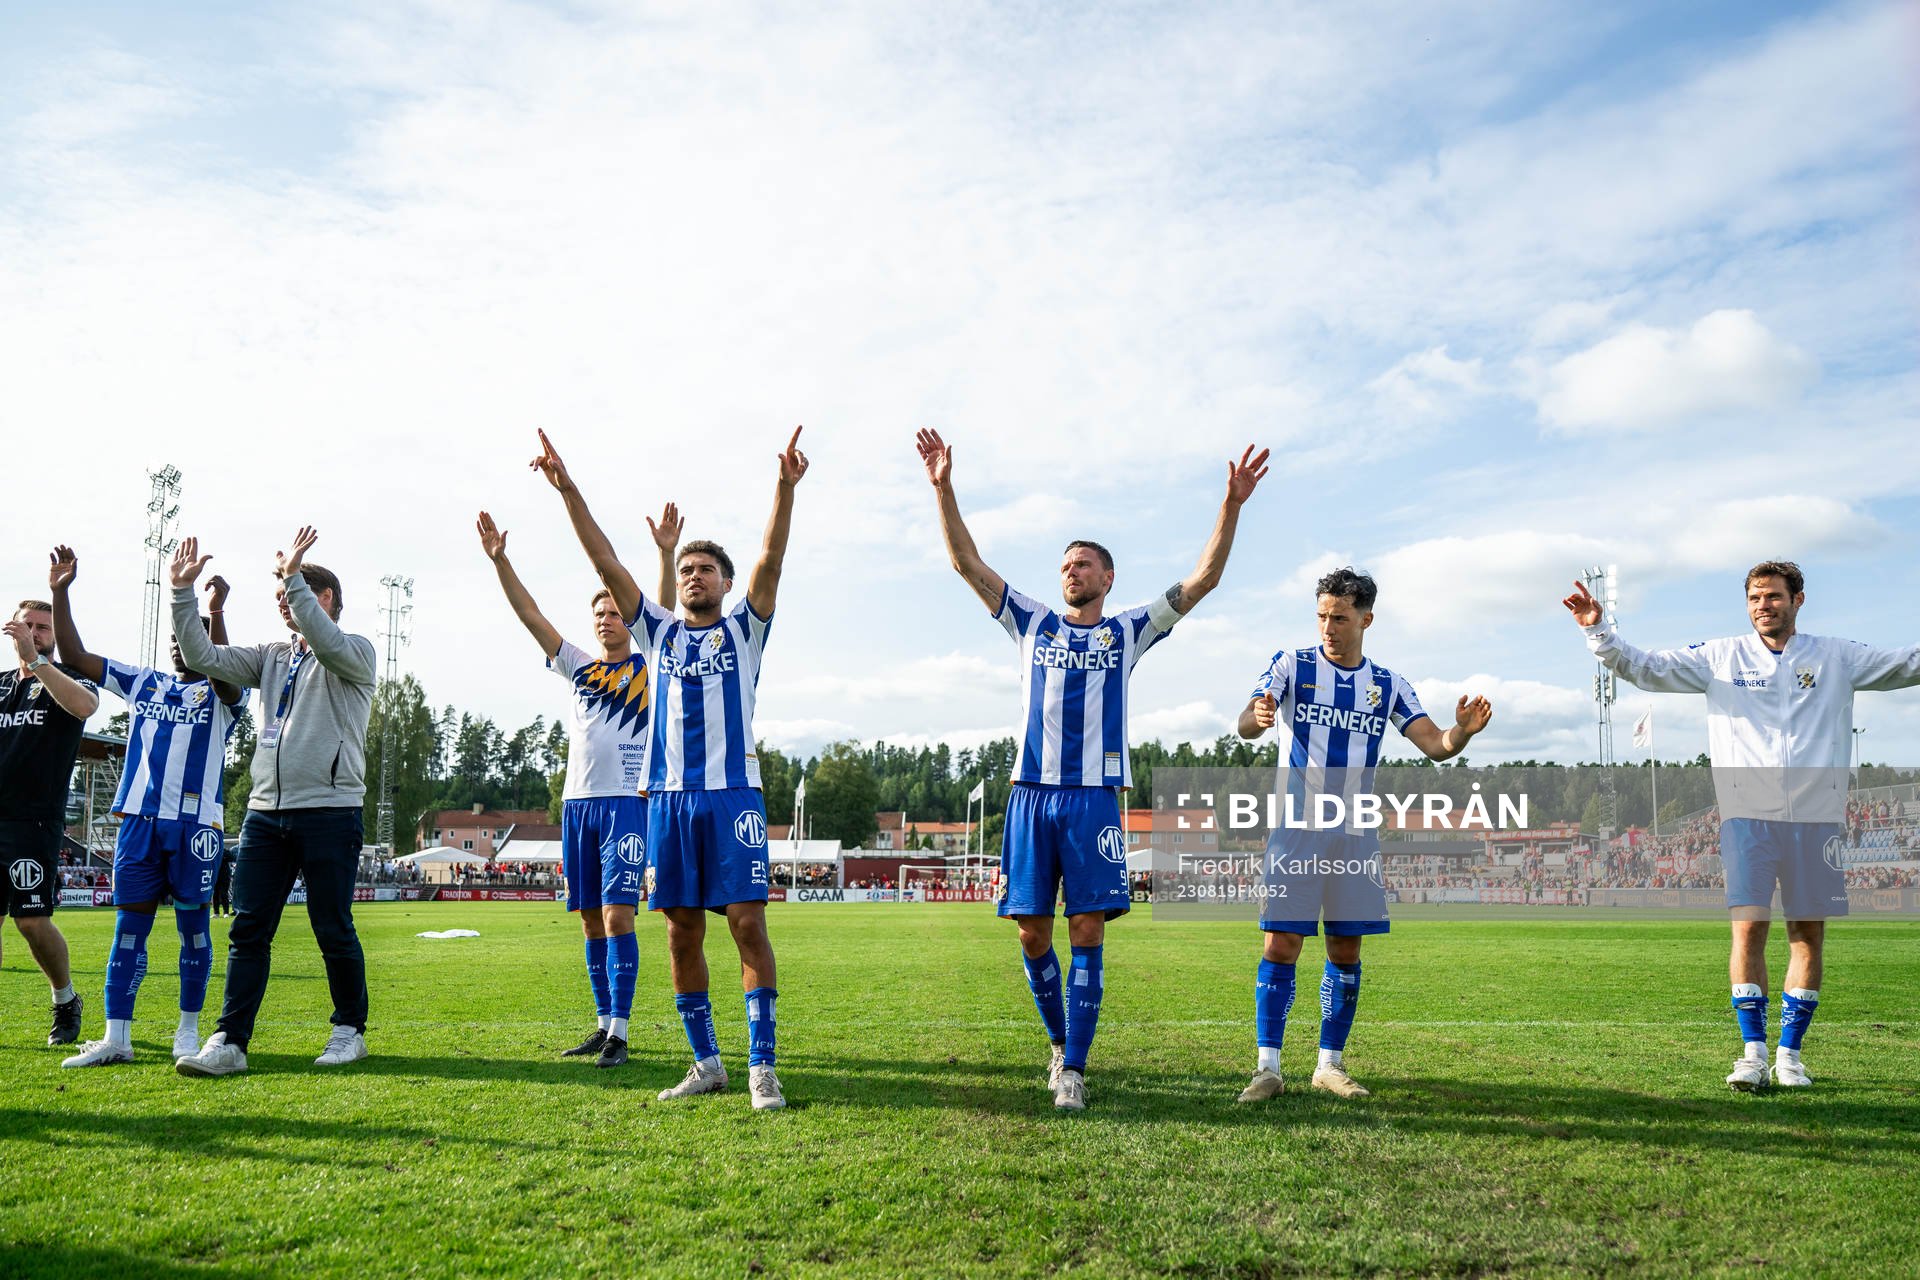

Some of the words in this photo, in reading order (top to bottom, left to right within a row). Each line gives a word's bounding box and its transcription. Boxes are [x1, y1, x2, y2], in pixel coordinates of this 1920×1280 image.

[1034, 647, 1119, 669] SERNEKE
[1733, 679, 1766, 687] SERNEKE
[0, 710, 44, 727] RNEKE
[135, 701, 209, 723] SERNEKE
[1295, 703, 1385, 736] SERNEKE
[738, 813, 766, 846] MG
[194, 831, 218, 859] MG
[620, 836, 643, 862] MG
[1100, 829, 1125, 860] MG
[11, 861, 41, 888] MG
[202, 870, 213, 883] 24
[623, 871, 639, 886] 34
[752, 861, 766, 878] 25
[1120, 870, 1127, 886] 9
[797, 890, 844, 901] GAAM
[927, 889, 992, 900] BAUHAUS
